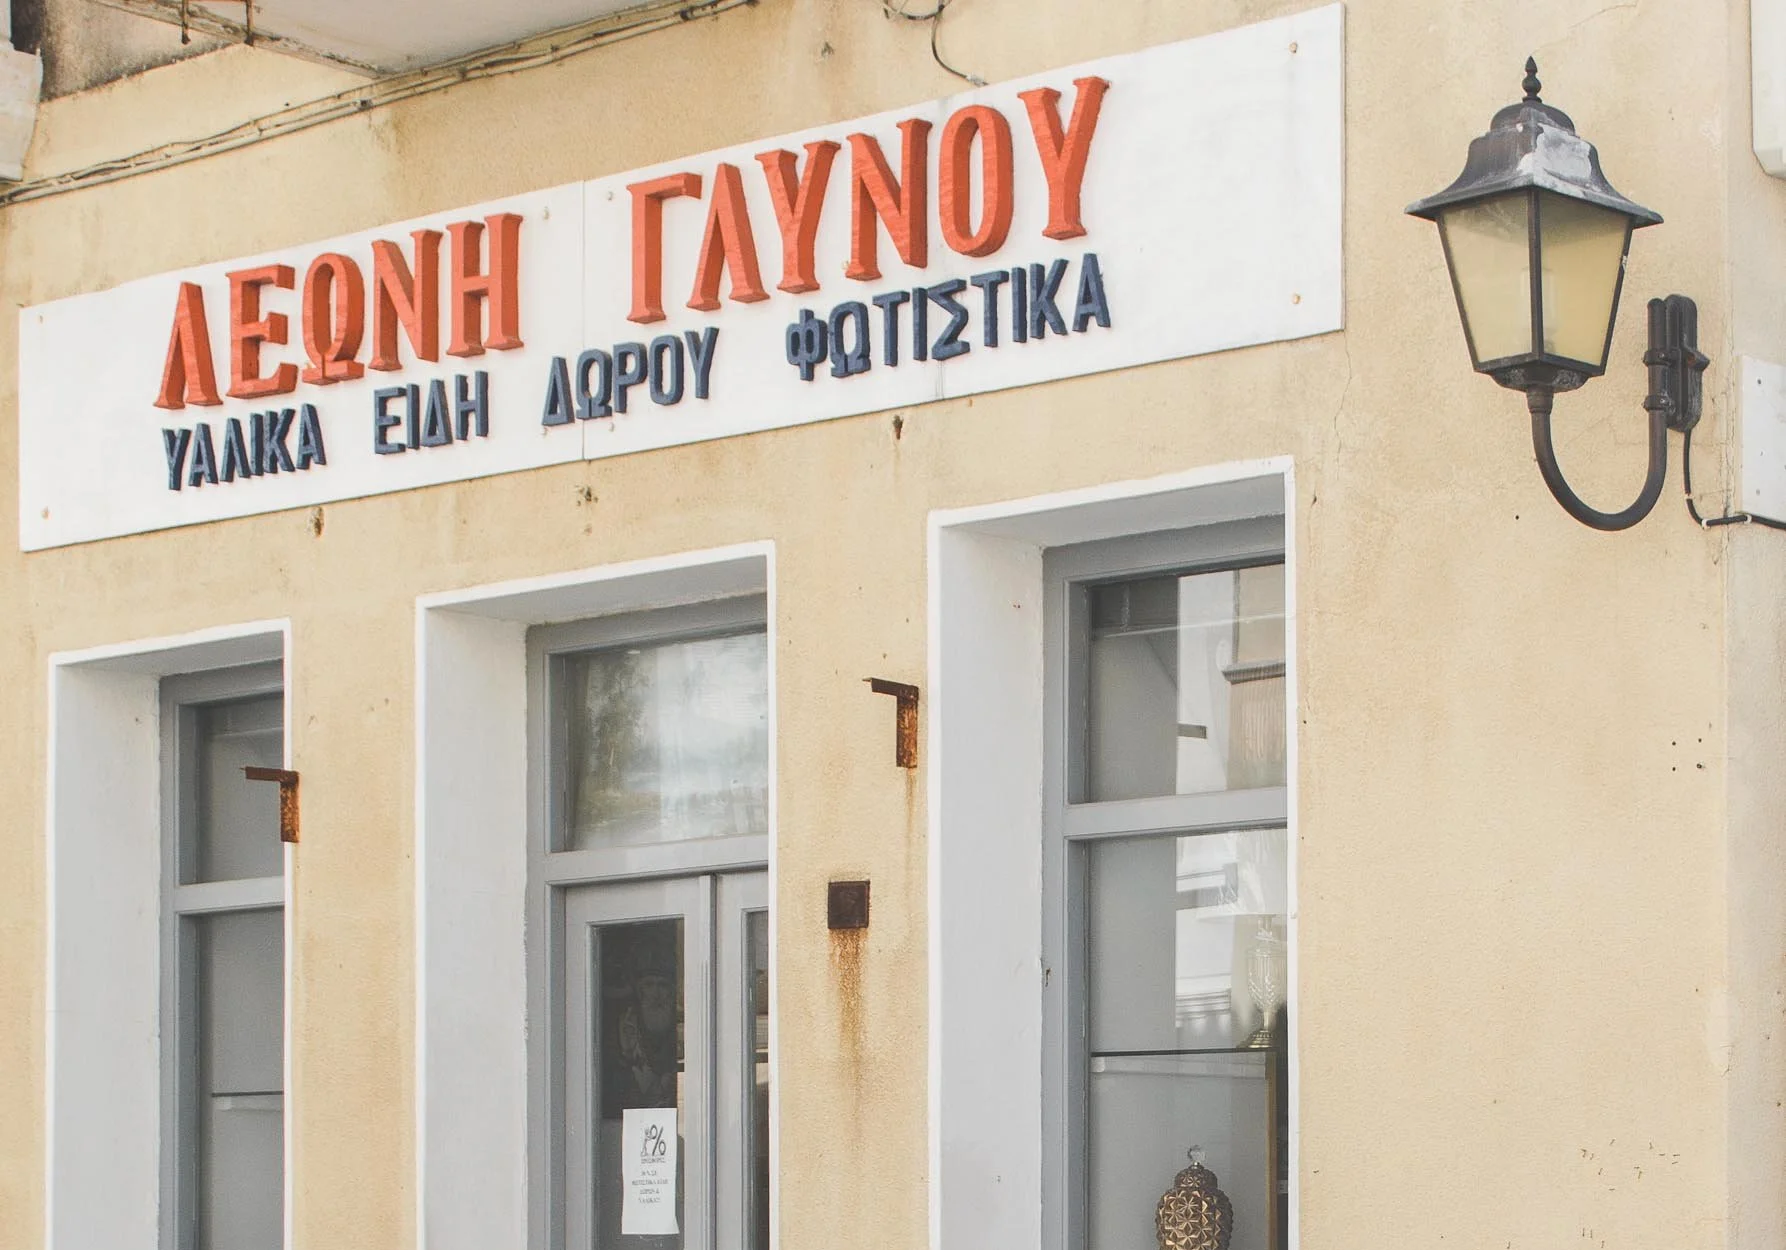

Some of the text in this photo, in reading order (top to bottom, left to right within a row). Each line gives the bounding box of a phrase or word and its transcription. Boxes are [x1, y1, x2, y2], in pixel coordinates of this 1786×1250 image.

[153, 76, 1109, 410] ΛΕΩΝΗ ΓΛΥΝΟΥ
[162, 253, 1111, 490] ΥΑΛΙΚΑ ΕΙΔΗ ΔΩΡΟΥ ΦΩΤΙΣΤΙΚΑ
